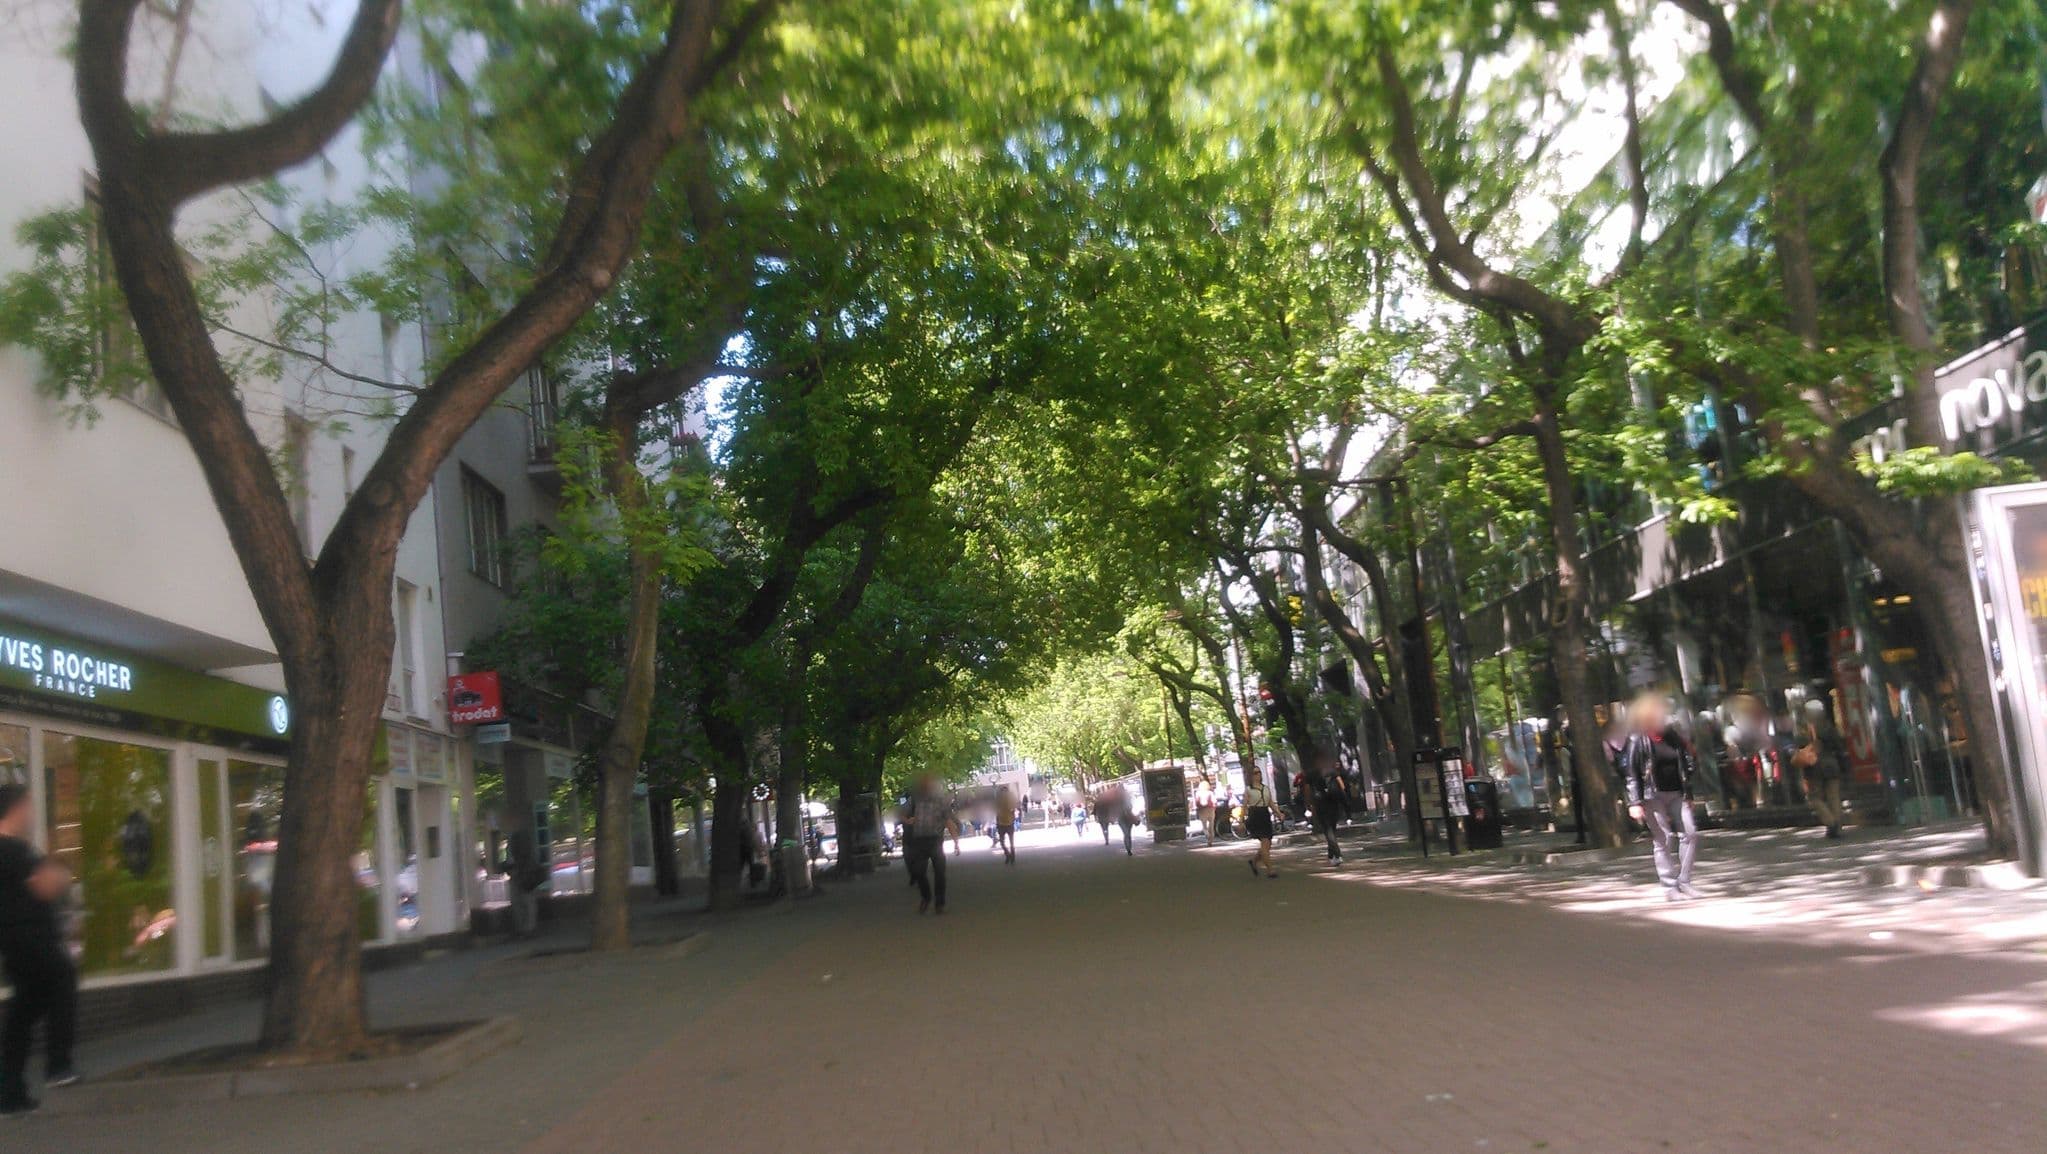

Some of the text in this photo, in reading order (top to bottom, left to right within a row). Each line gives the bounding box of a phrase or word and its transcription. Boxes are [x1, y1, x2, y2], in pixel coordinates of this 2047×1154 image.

[1939, 350, 2047, 442] nova
[35, 674, 96, 698] FRANCE
[52, 649, 131, 691] ROCHER
[451, 705, 497, 722] trodat
